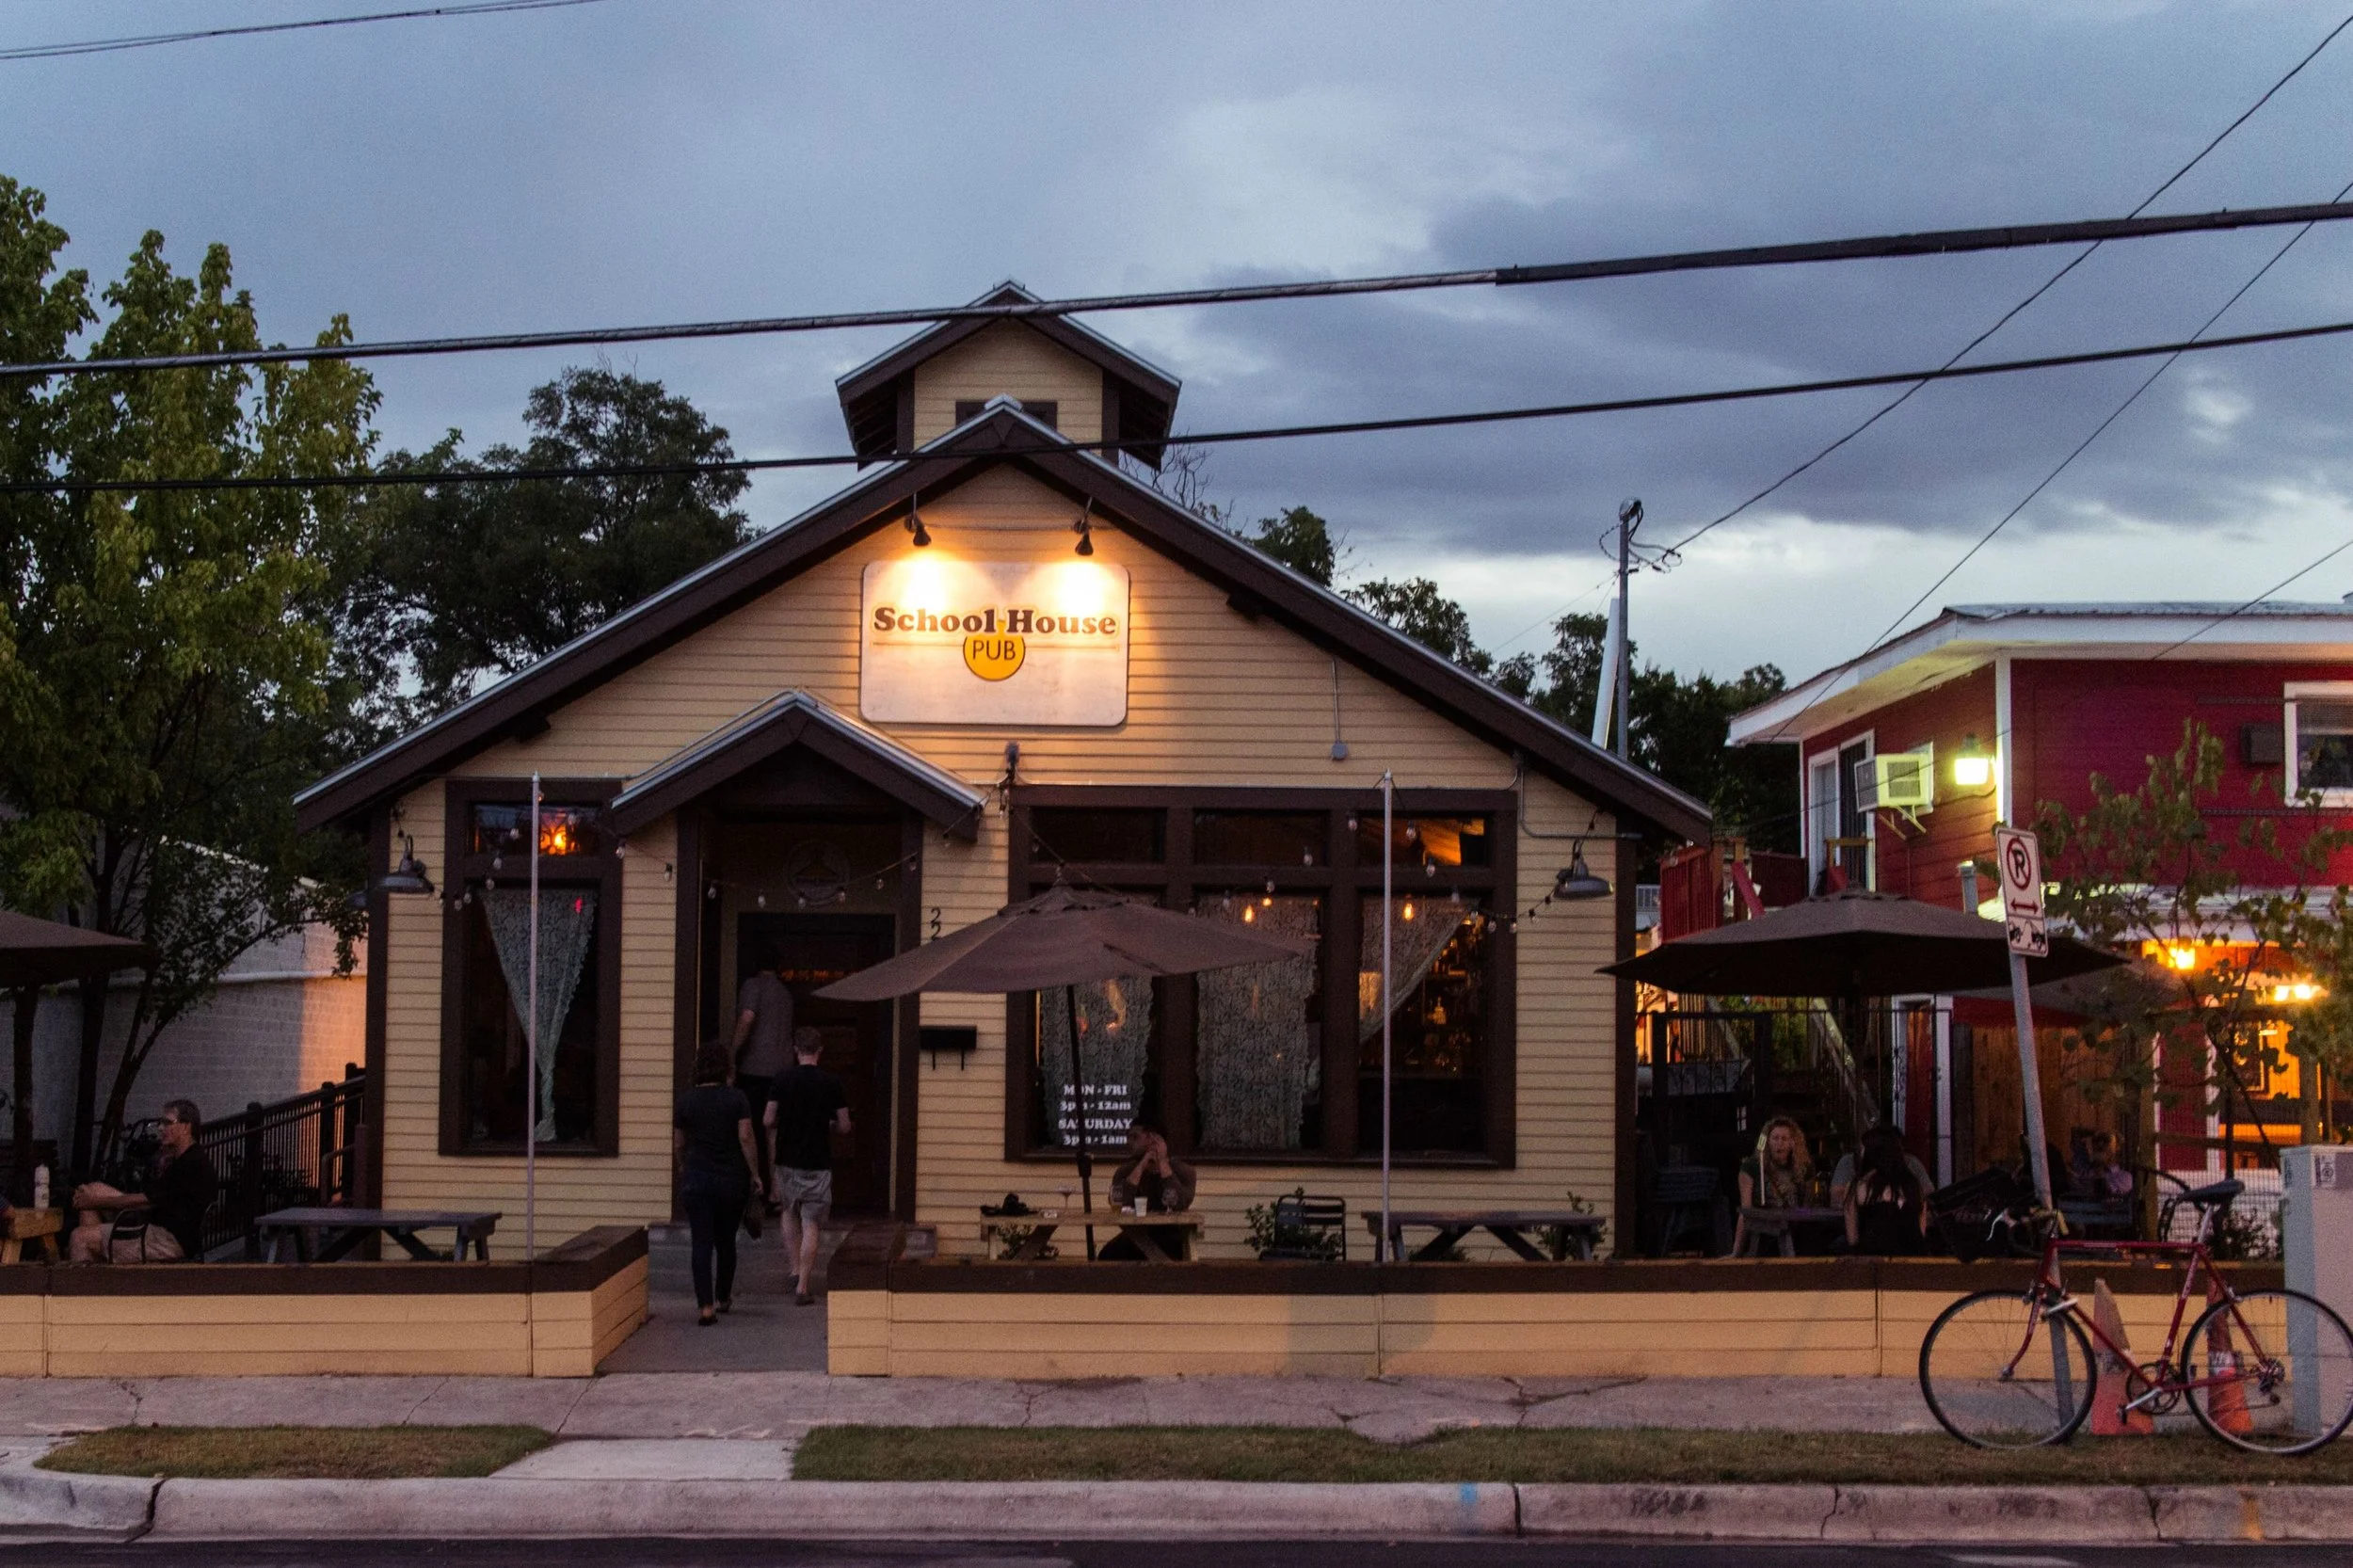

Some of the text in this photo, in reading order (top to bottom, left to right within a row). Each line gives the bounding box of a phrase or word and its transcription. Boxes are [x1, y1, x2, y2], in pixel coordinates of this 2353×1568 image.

[873, 607, 1116, 634] School House
[972, 640, 1016, 661] PUB
[1064, 1084, 1095, 1096] MN
[1104, 1084, 1128, 1096] FRI
[1098, 1101, 1131, 1110] 12am
[1058, 1118, 1133, 1129] SAURDAY
[1100, 1135, 1128, 1144] 1am
